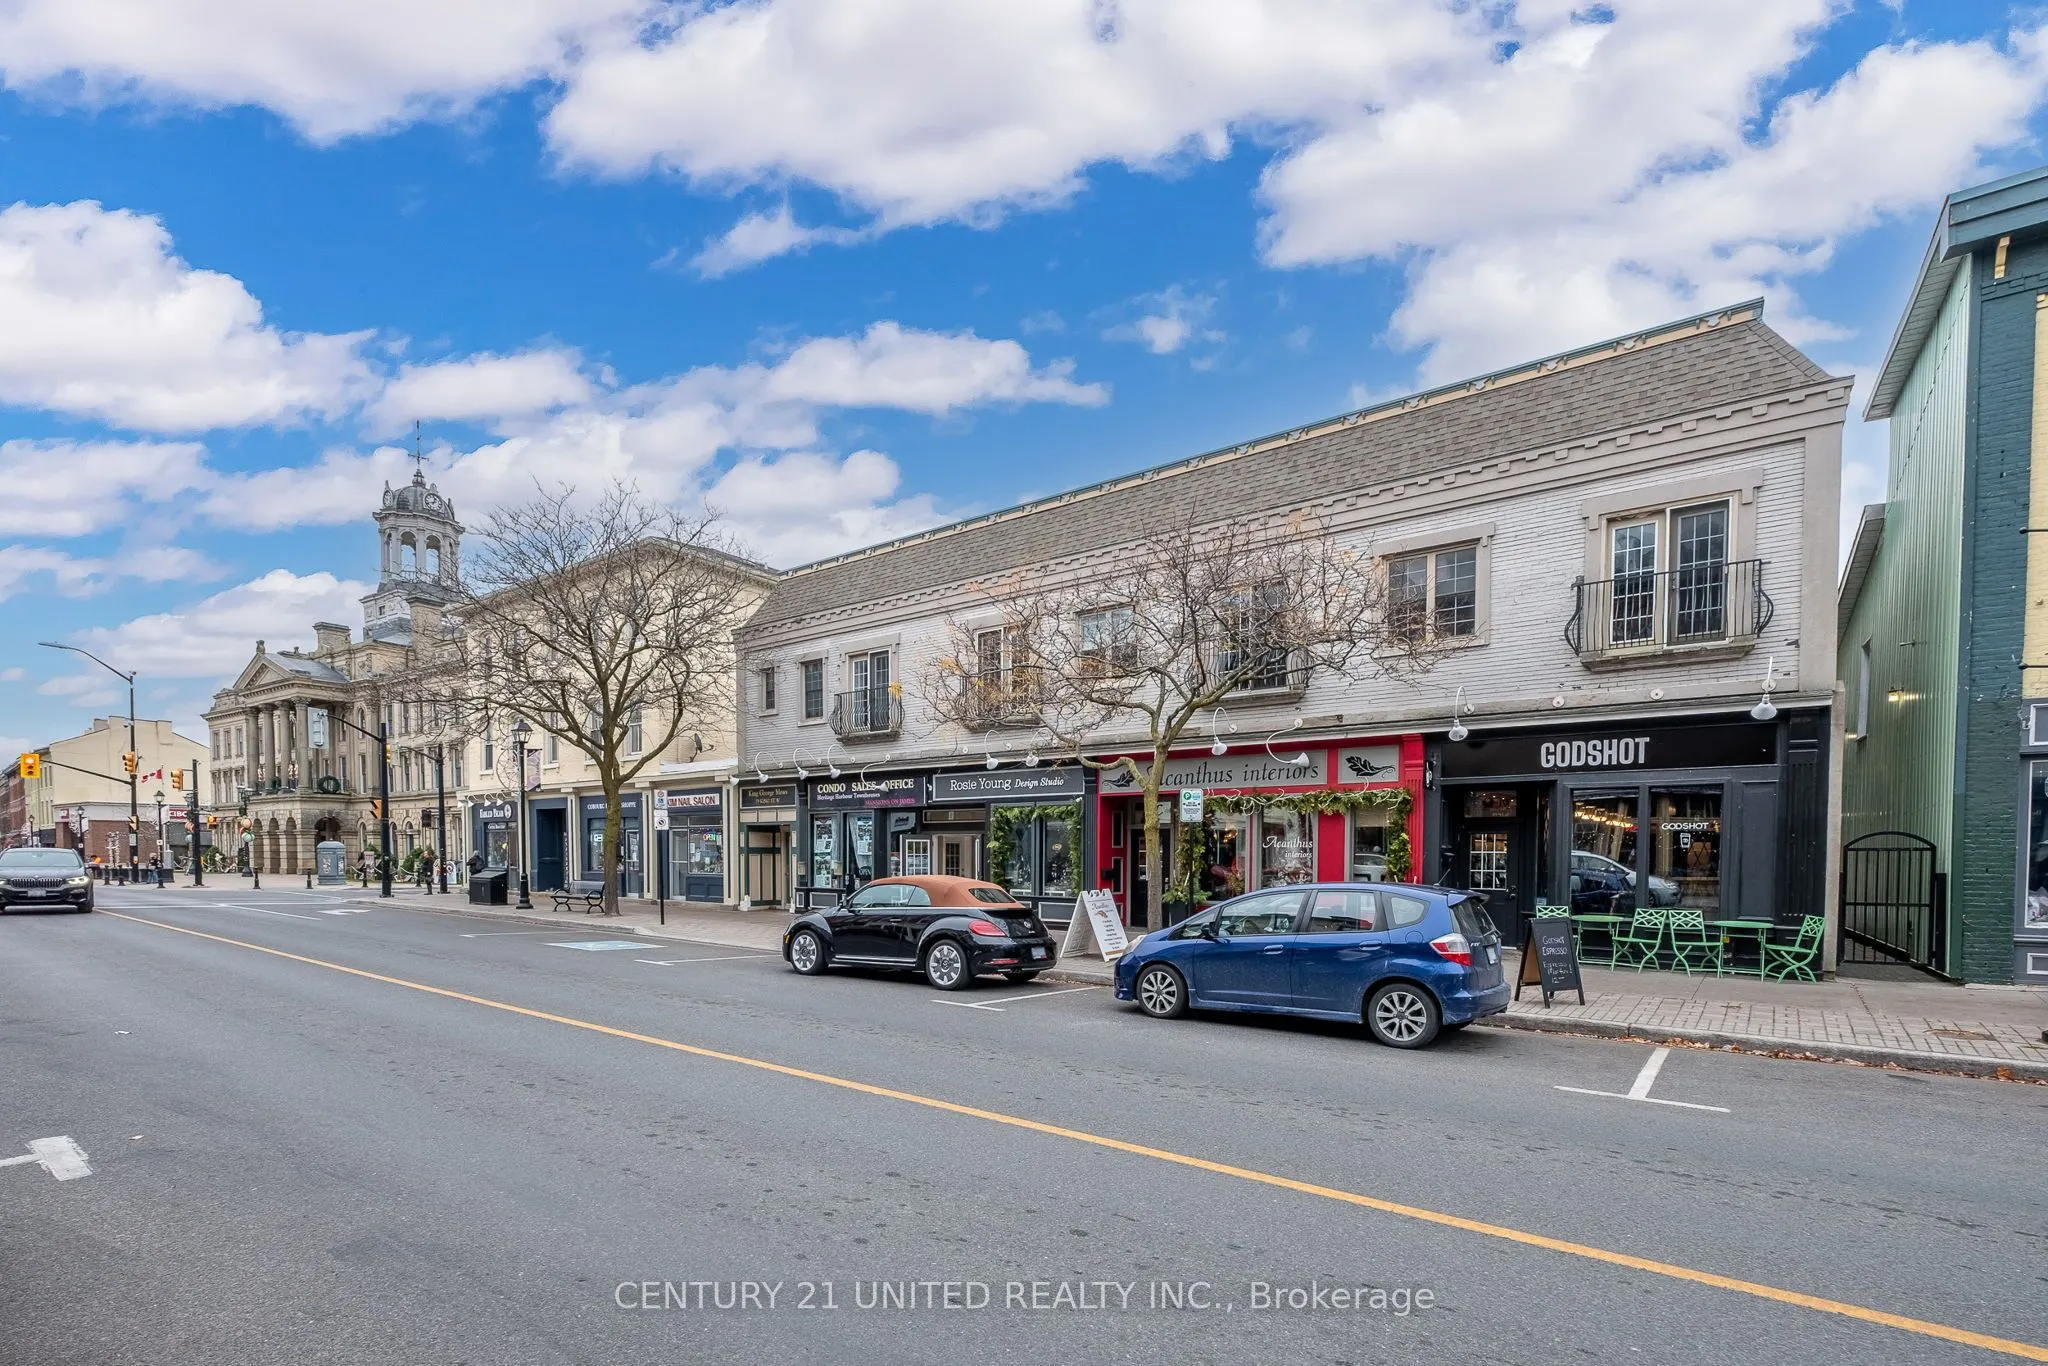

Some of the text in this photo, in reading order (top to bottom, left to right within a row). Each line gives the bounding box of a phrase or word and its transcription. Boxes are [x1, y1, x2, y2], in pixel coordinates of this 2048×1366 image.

[1541, 737, 1650, 768] GODSHOT
[1243, 762, 1319, 782] interiors
[817, 779, 914, 794] CONDO SALES OFFICE
[950, 776, 1065, 791] Rosie Young Design Studio
[678, 798, 691, 806] NAIL
[693, 796, 715, 805] SALON
[1661, 822, 1710, 830] GODSHOT
[1262, 835, 1313, 848] Acanthus
[1285, 850, 1312, 859] interiors
